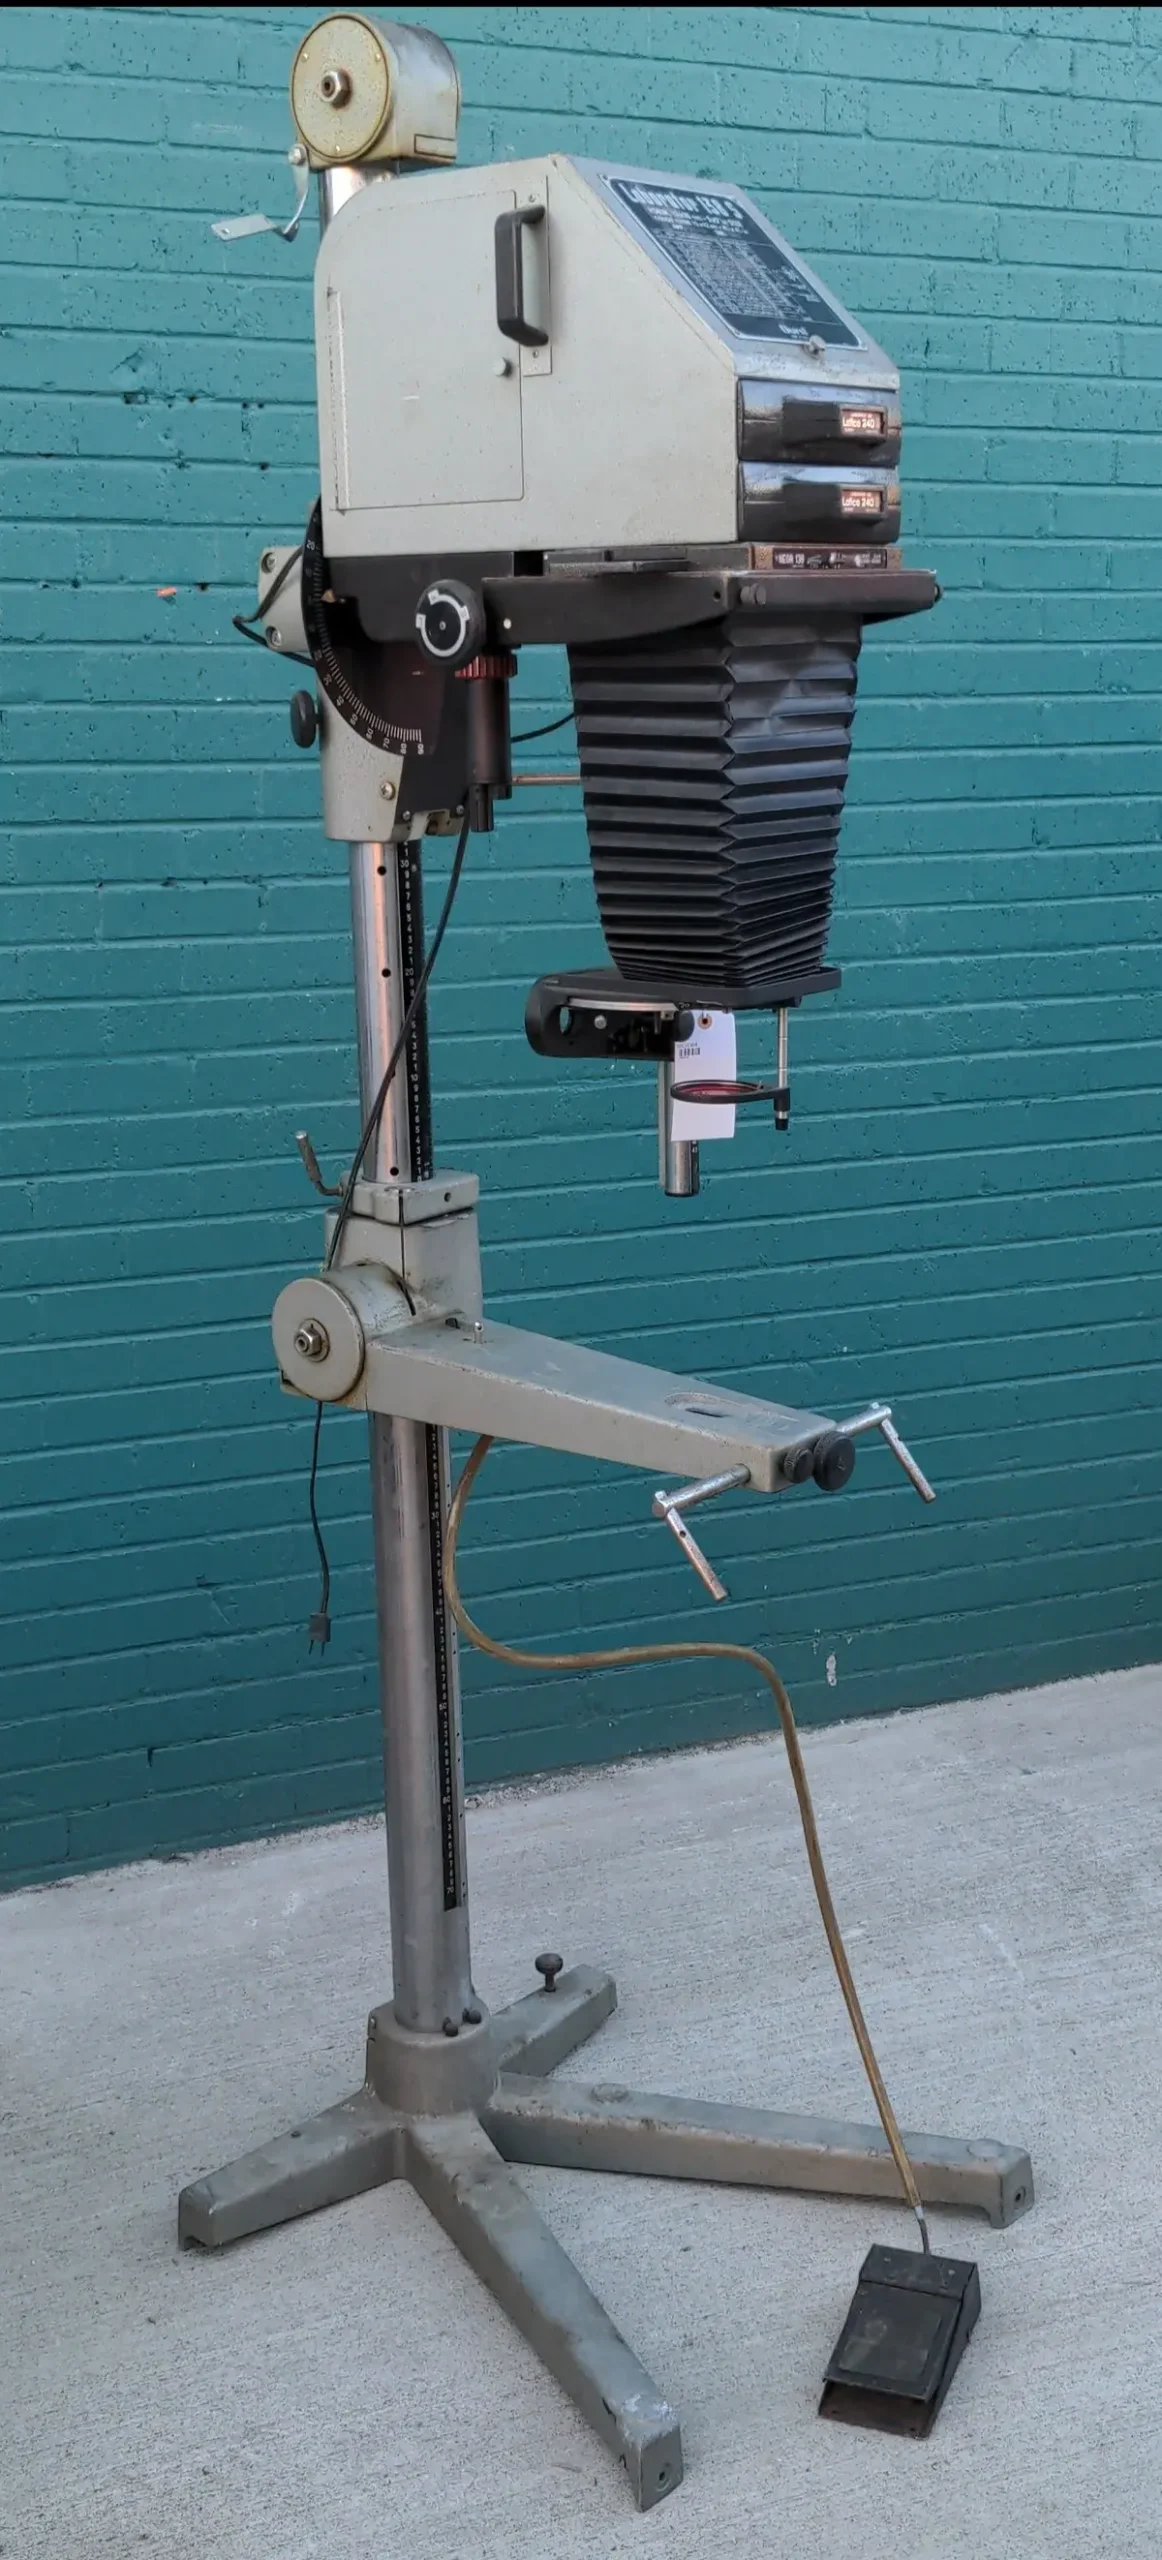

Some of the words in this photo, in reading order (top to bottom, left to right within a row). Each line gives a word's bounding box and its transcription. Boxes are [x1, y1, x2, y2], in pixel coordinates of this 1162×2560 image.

[618, 182, 700, 213] Laborator
[861, 418, 875, 429] 240
[861, 497, 875, 508] 240
[382, 737, 390, 749] 70
[400, 859, 410, 868] 30
[405, 967, 414, 976] 20
[410, 1073, 419, 1082] 10
